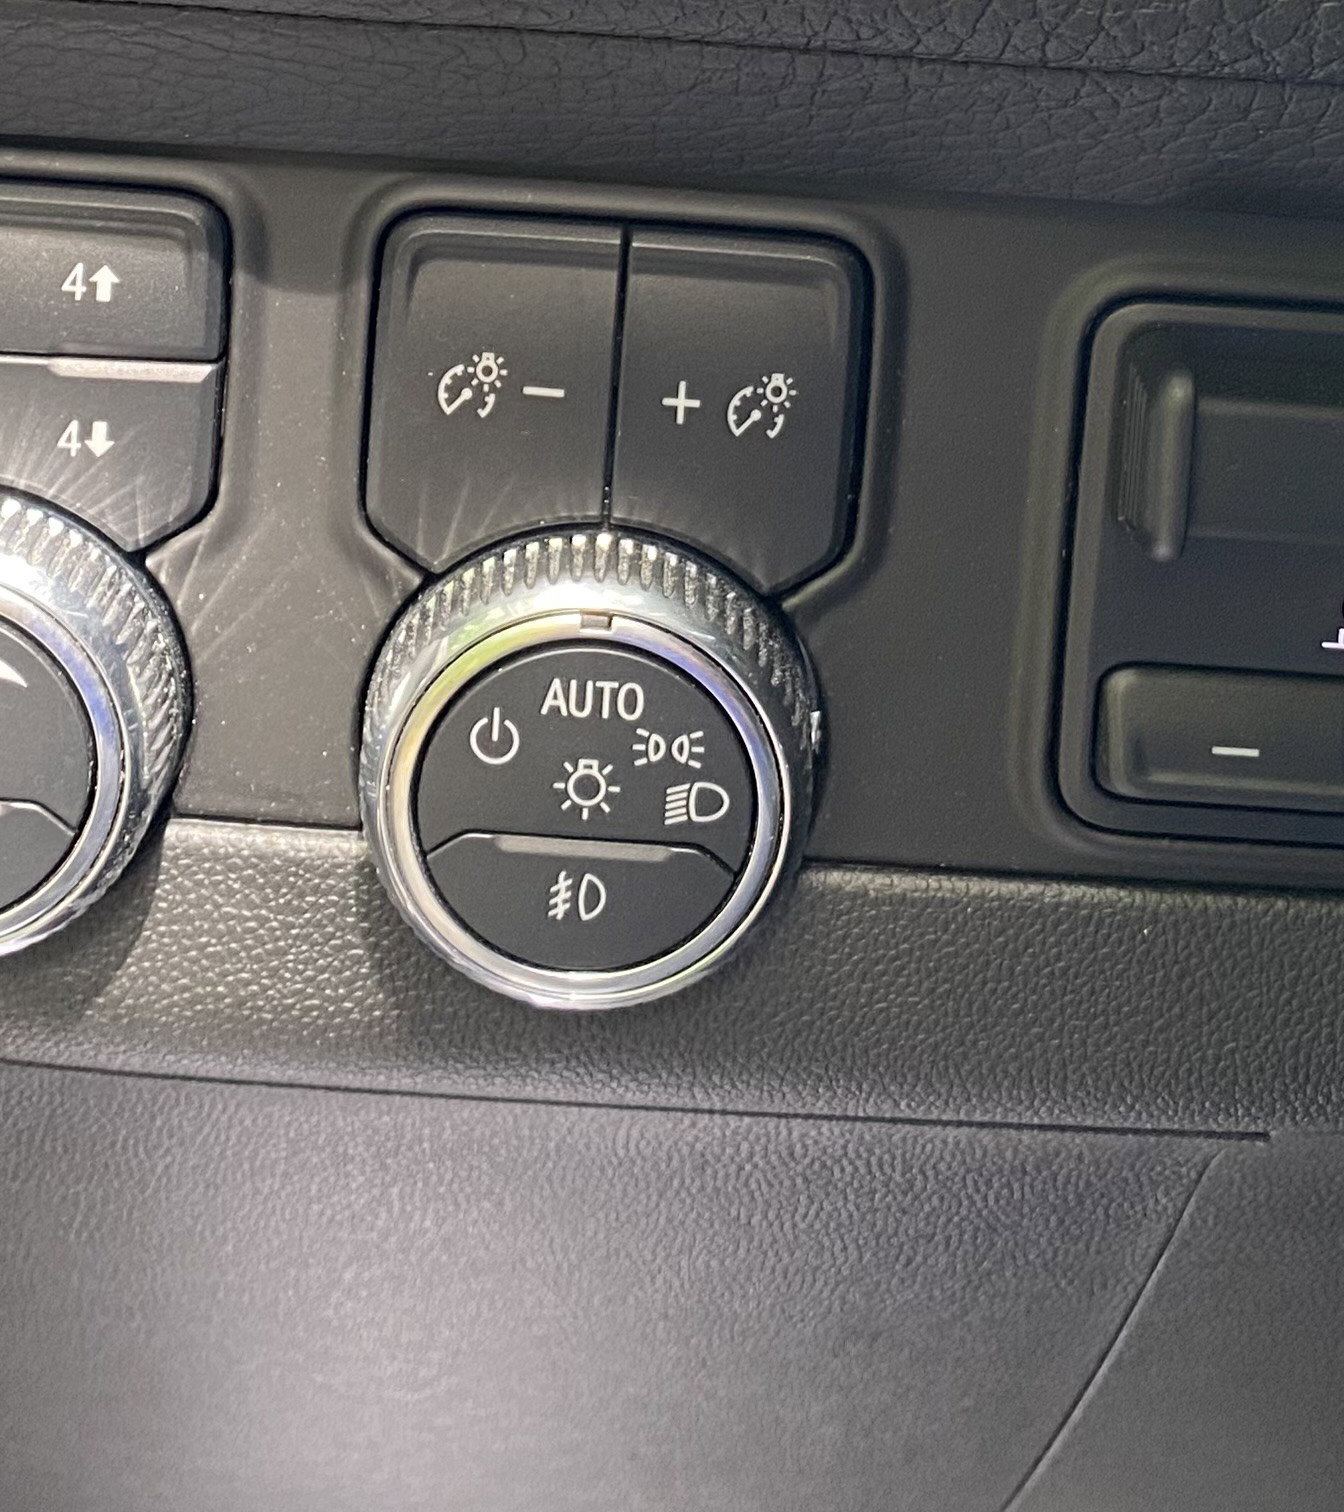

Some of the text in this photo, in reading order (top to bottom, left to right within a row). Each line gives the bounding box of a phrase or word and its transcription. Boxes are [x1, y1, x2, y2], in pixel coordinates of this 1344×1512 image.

[60, 262, 87, 302] 4
[56, 420, 82, 459] 4
[541, 678, 645, 722] AUTO
